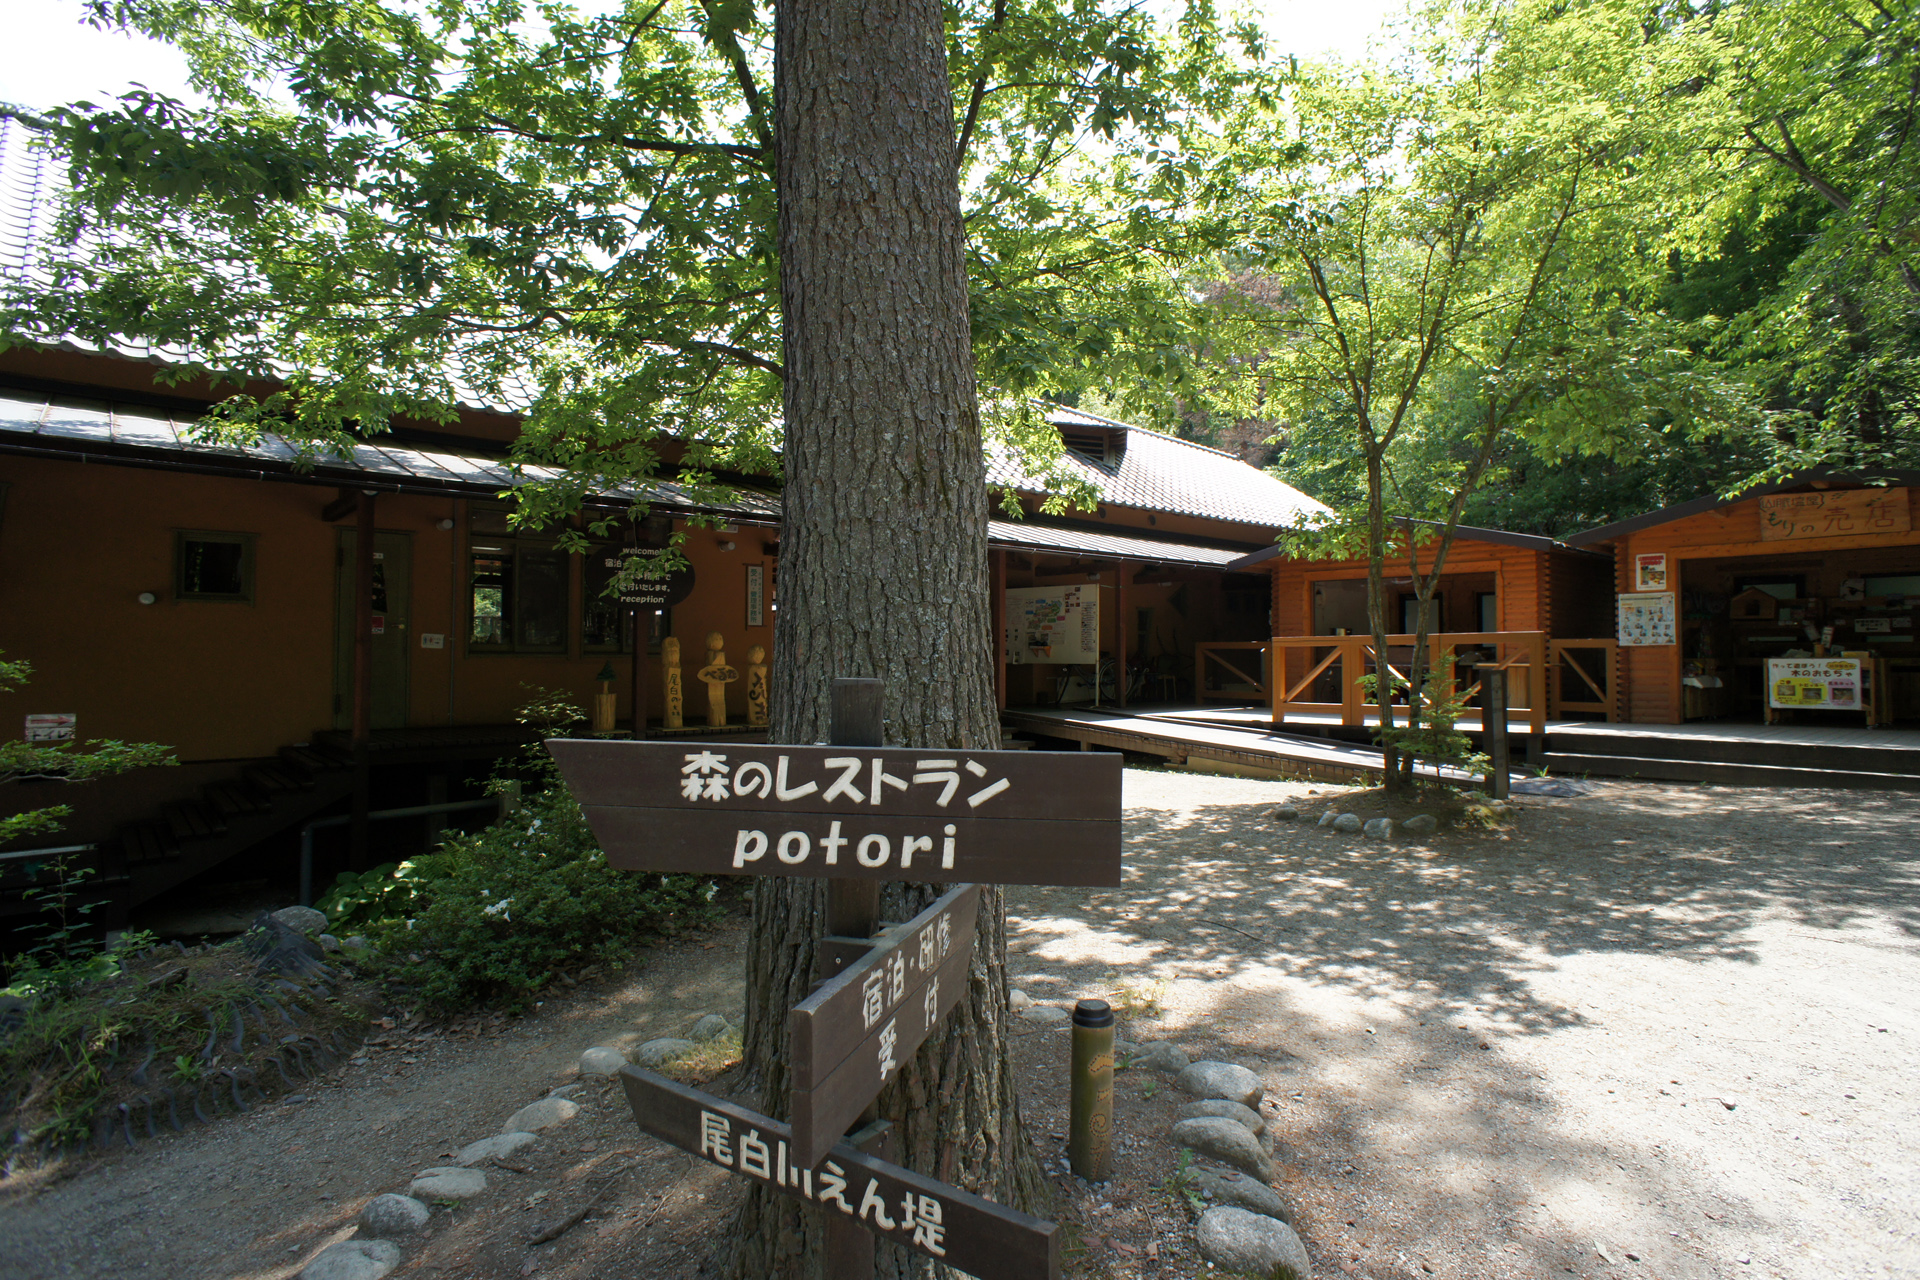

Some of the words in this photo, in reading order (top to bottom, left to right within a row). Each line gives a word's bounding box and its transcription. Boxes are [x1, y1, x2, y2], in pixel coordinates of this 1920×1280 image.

[1768, 501, 1897, 537] もりの売店
[1791, 669, 1853, 677] 木のおもちゃ
[680, 750, 1011, 808] 森のレストラン
[732, 821, 957, 869] potori
[862, 911, 952, 1030] 宿泊・研修
[877, 981, 940, 1080] 受付
[700, 1110, 946, 1257] 尾白川えん堤
